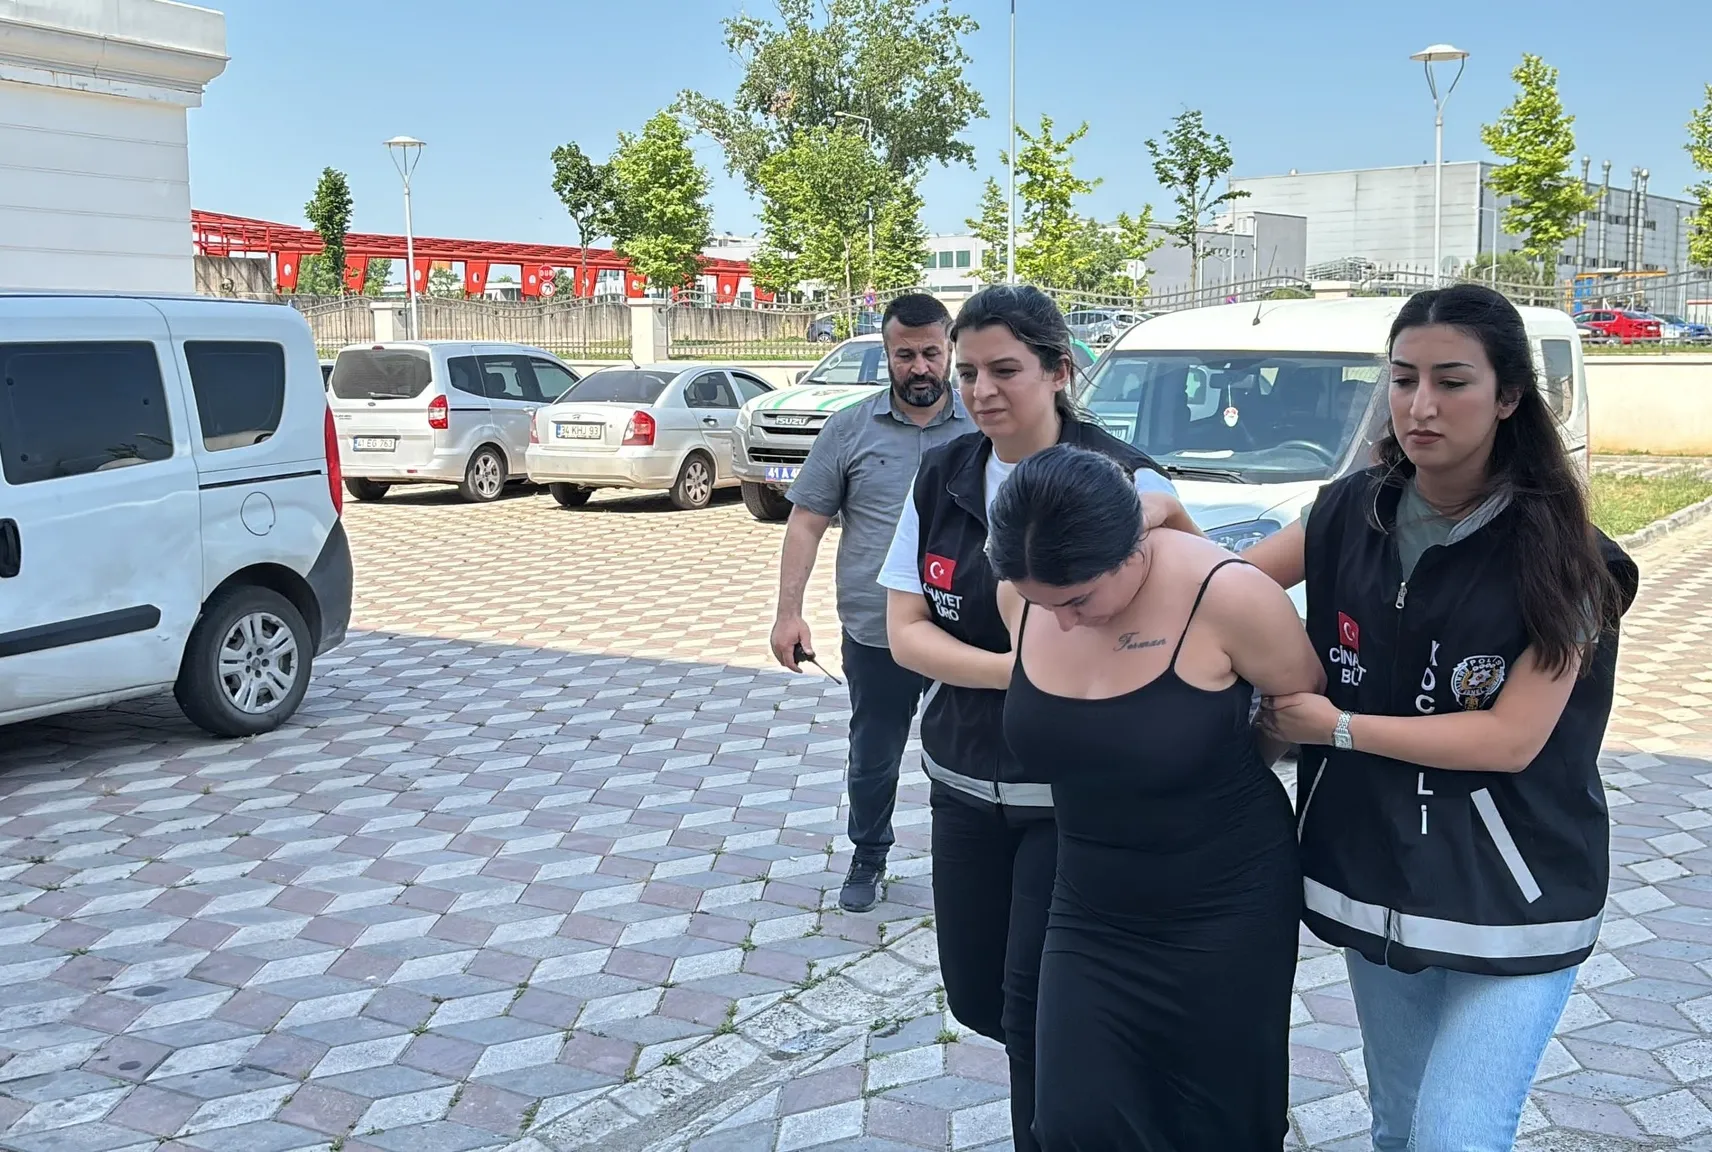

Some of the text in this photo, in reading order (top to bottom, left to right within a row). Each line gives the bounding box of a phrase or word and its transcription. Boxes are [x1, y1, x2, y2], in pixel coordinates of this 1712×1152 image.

[776, 416, 806, 425] ISUZU
[589, 425, 598, 435] 93
[767, 467, 779, 479] 41
[781, 467, 790, 479] A
